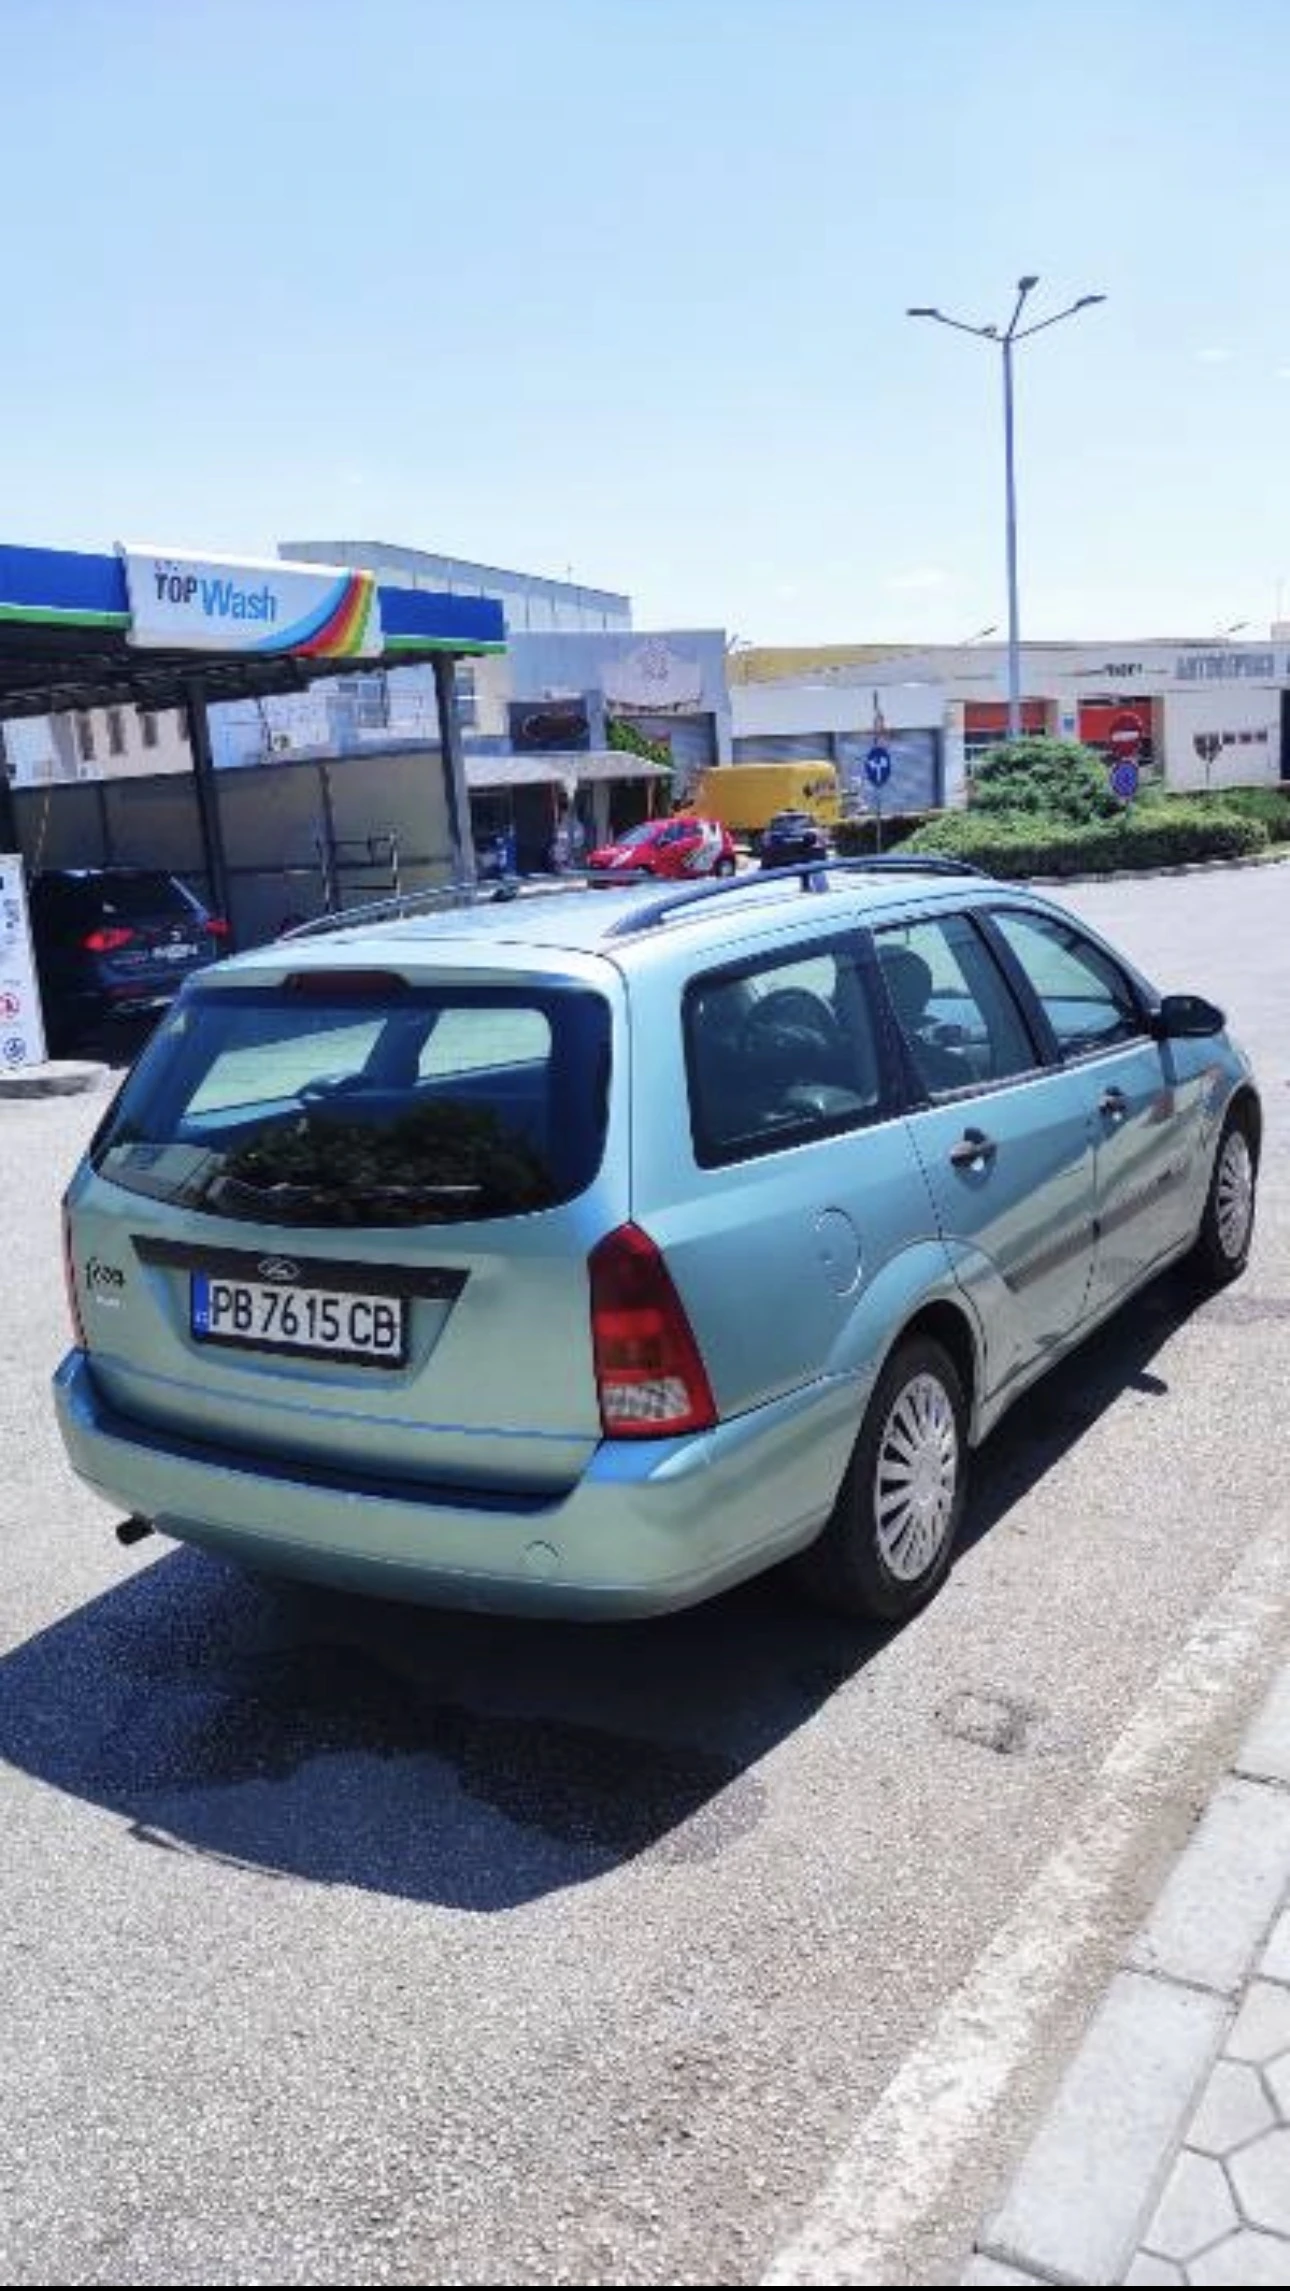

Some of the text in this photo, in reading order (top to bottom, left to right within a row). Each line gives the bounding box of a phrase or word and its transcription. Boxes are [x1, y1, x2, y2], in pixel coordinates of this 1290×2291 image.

[154, 573, 277, 622] TOP Wash
[212, 1286, 396, 1348] PB 7615 CB
